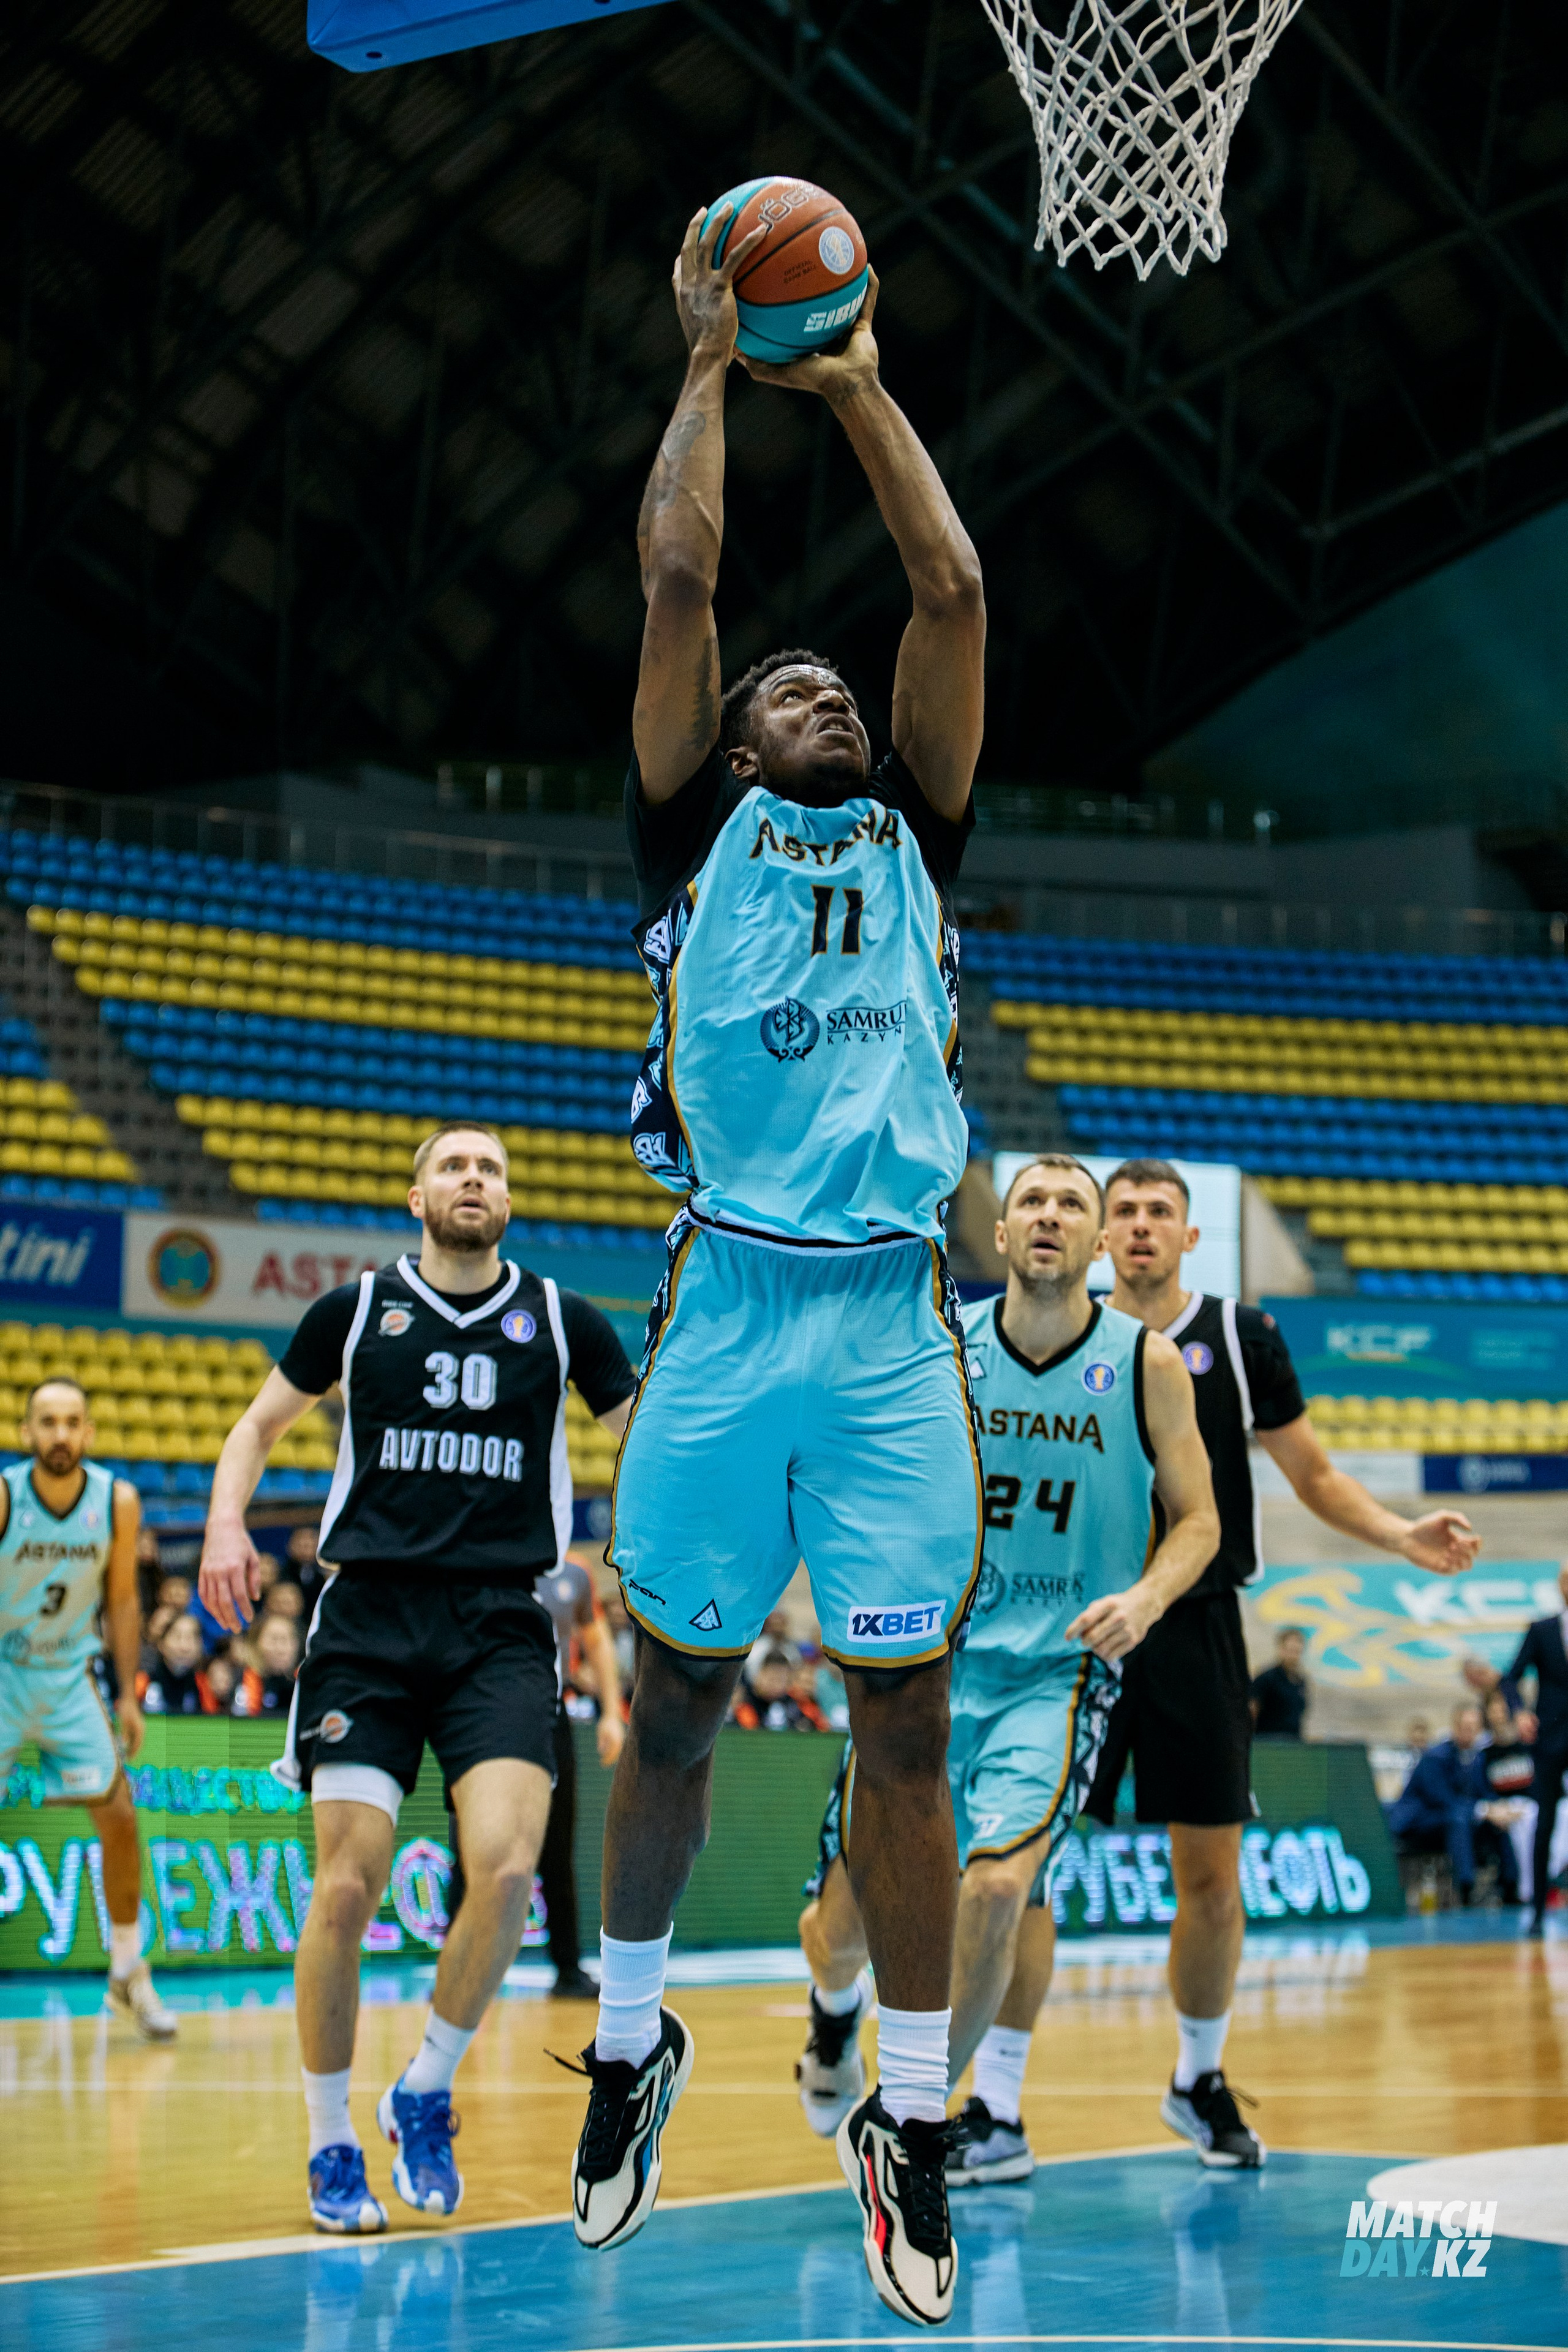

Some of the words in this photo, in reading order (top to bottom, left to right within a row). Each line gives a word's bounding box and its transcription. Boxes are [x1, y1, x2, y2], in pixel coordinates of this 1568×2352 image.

[810, 884, 864, 957] 11
[252, 1251, 377, 1300] AST
[423, 1351, 497, 1411] 30
[379, 1427, 524, 1482] AVTODOR
[986, 1474, 1076, 1533] 24
[40, 1581, 66, 1616] 3
[852, 1606, 941, 1636] 1XBET
